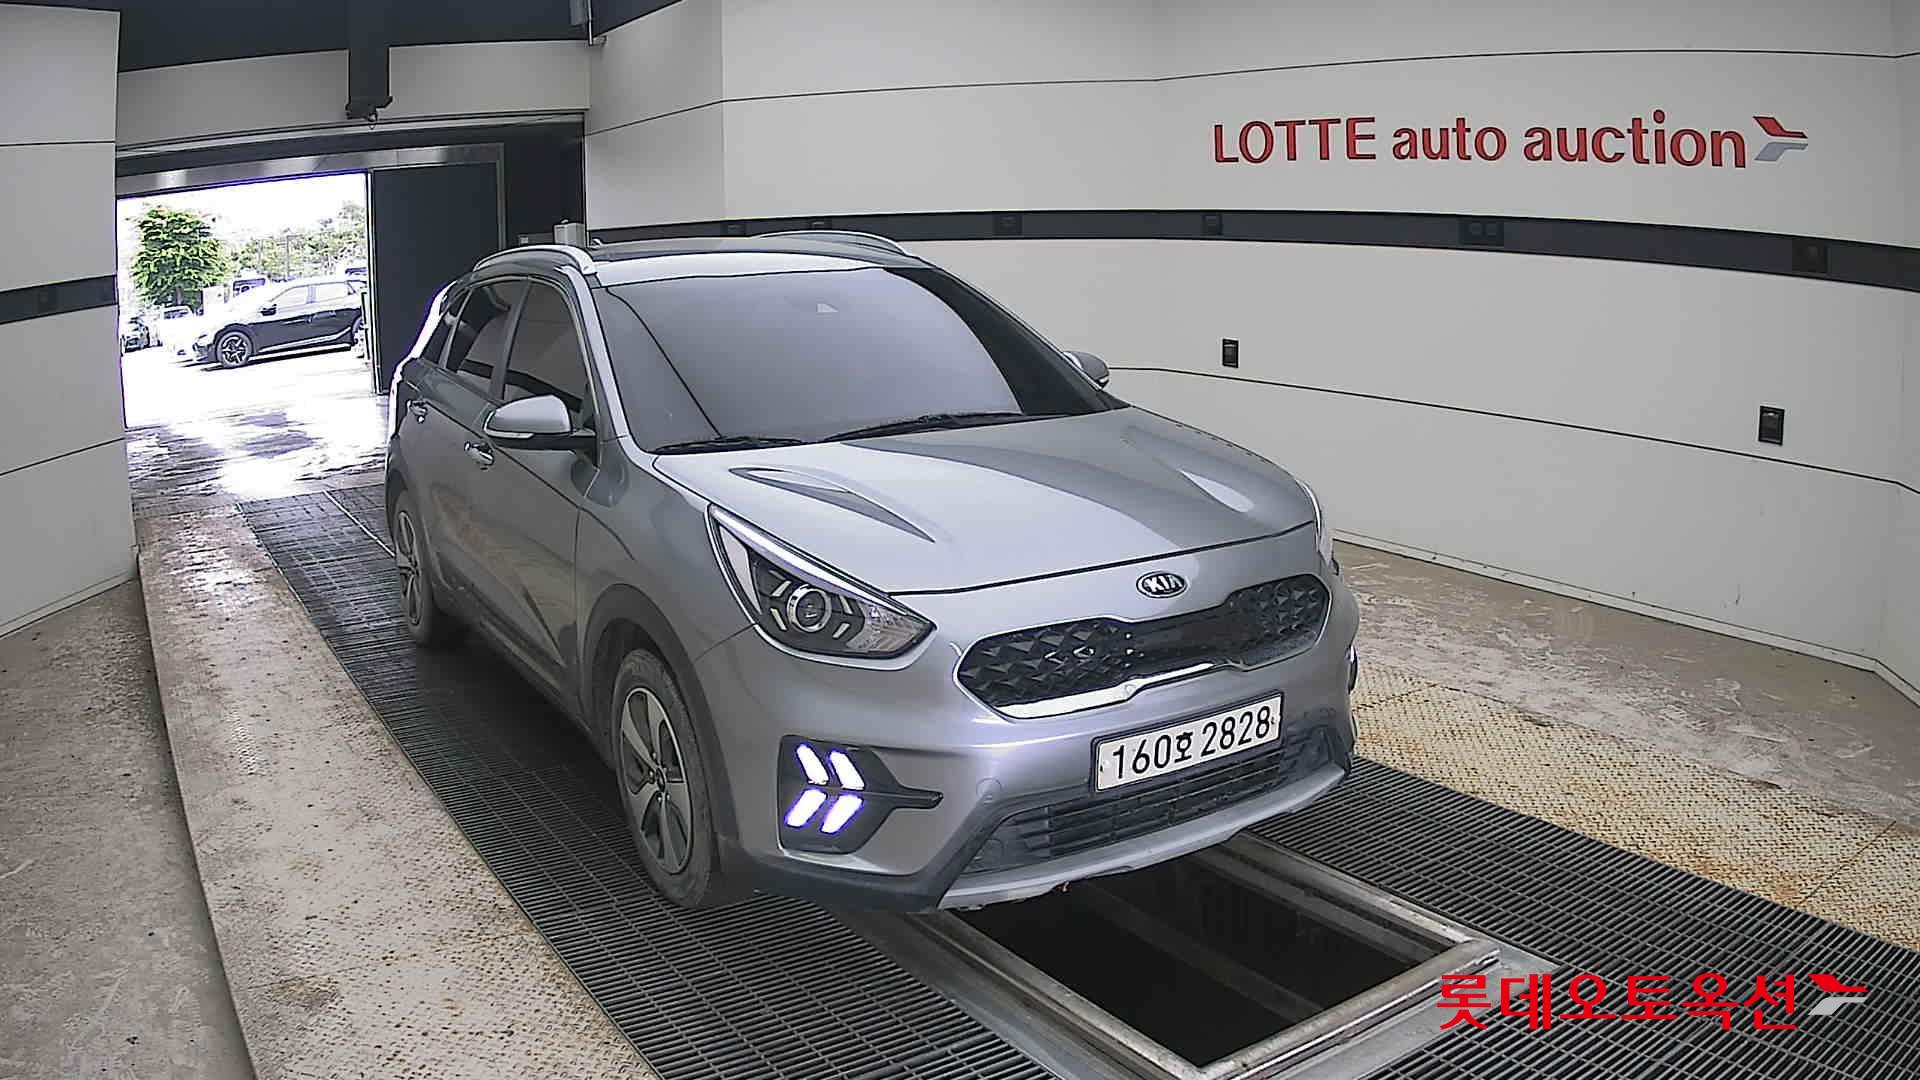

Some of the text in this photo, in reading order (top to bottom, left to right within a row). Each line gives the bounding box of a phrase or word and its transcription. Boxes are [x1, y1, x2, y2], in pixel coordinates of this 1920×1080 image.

[1214, 109, 1746, 168] LOTTE auto auction
[1143, 571, 1183, 593] KIA
[1113, 706, 1271, 779] 160호 2828
